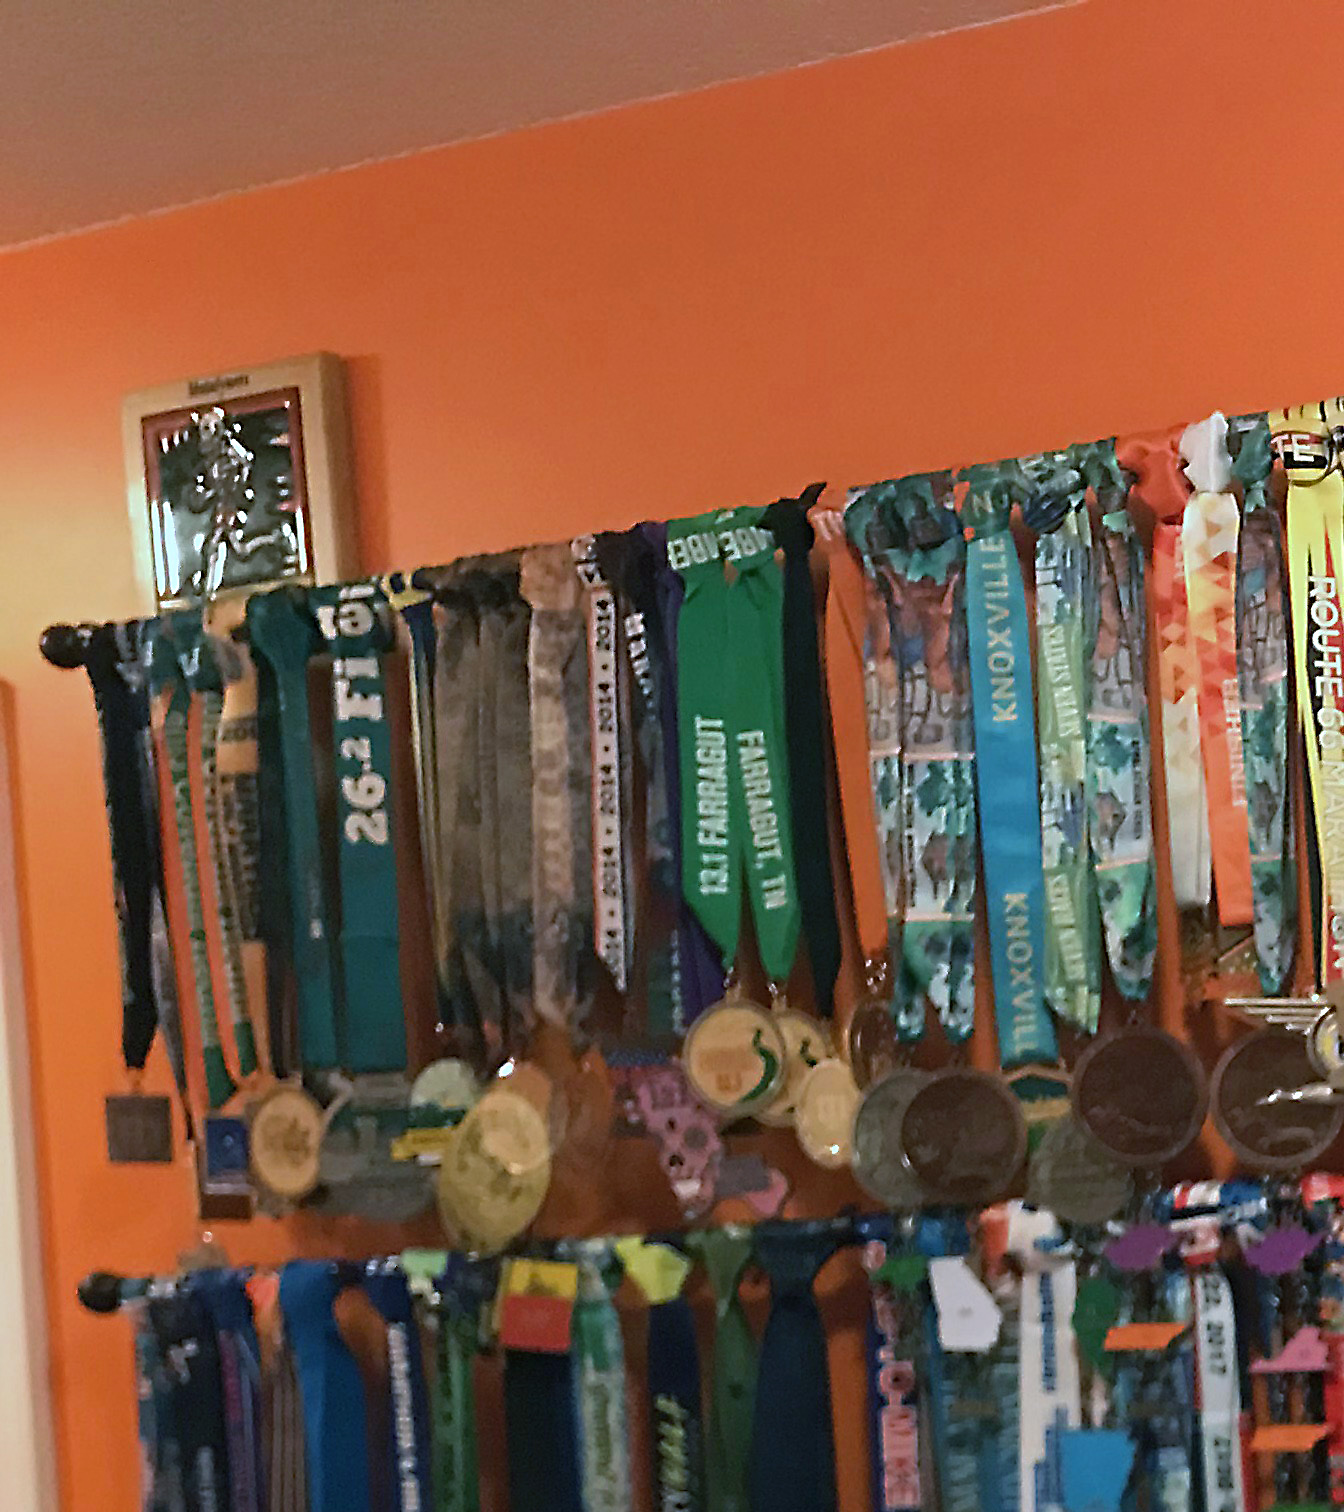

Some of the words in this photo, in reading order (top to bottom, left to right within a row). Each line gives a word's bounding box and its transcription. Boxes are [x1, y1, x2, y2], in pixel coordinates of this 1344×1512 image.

[991, 535, 1019, 724] KNOXVILLE
[1307, 574, 1344, 697] ROUTE
[344, 736, 391, 846] 26.2
[694, 716, 729, 848] FARRAGUT
[763, 874, 787, 910] TN
[1003, 893, 1028, 1054] KNOXVILL
